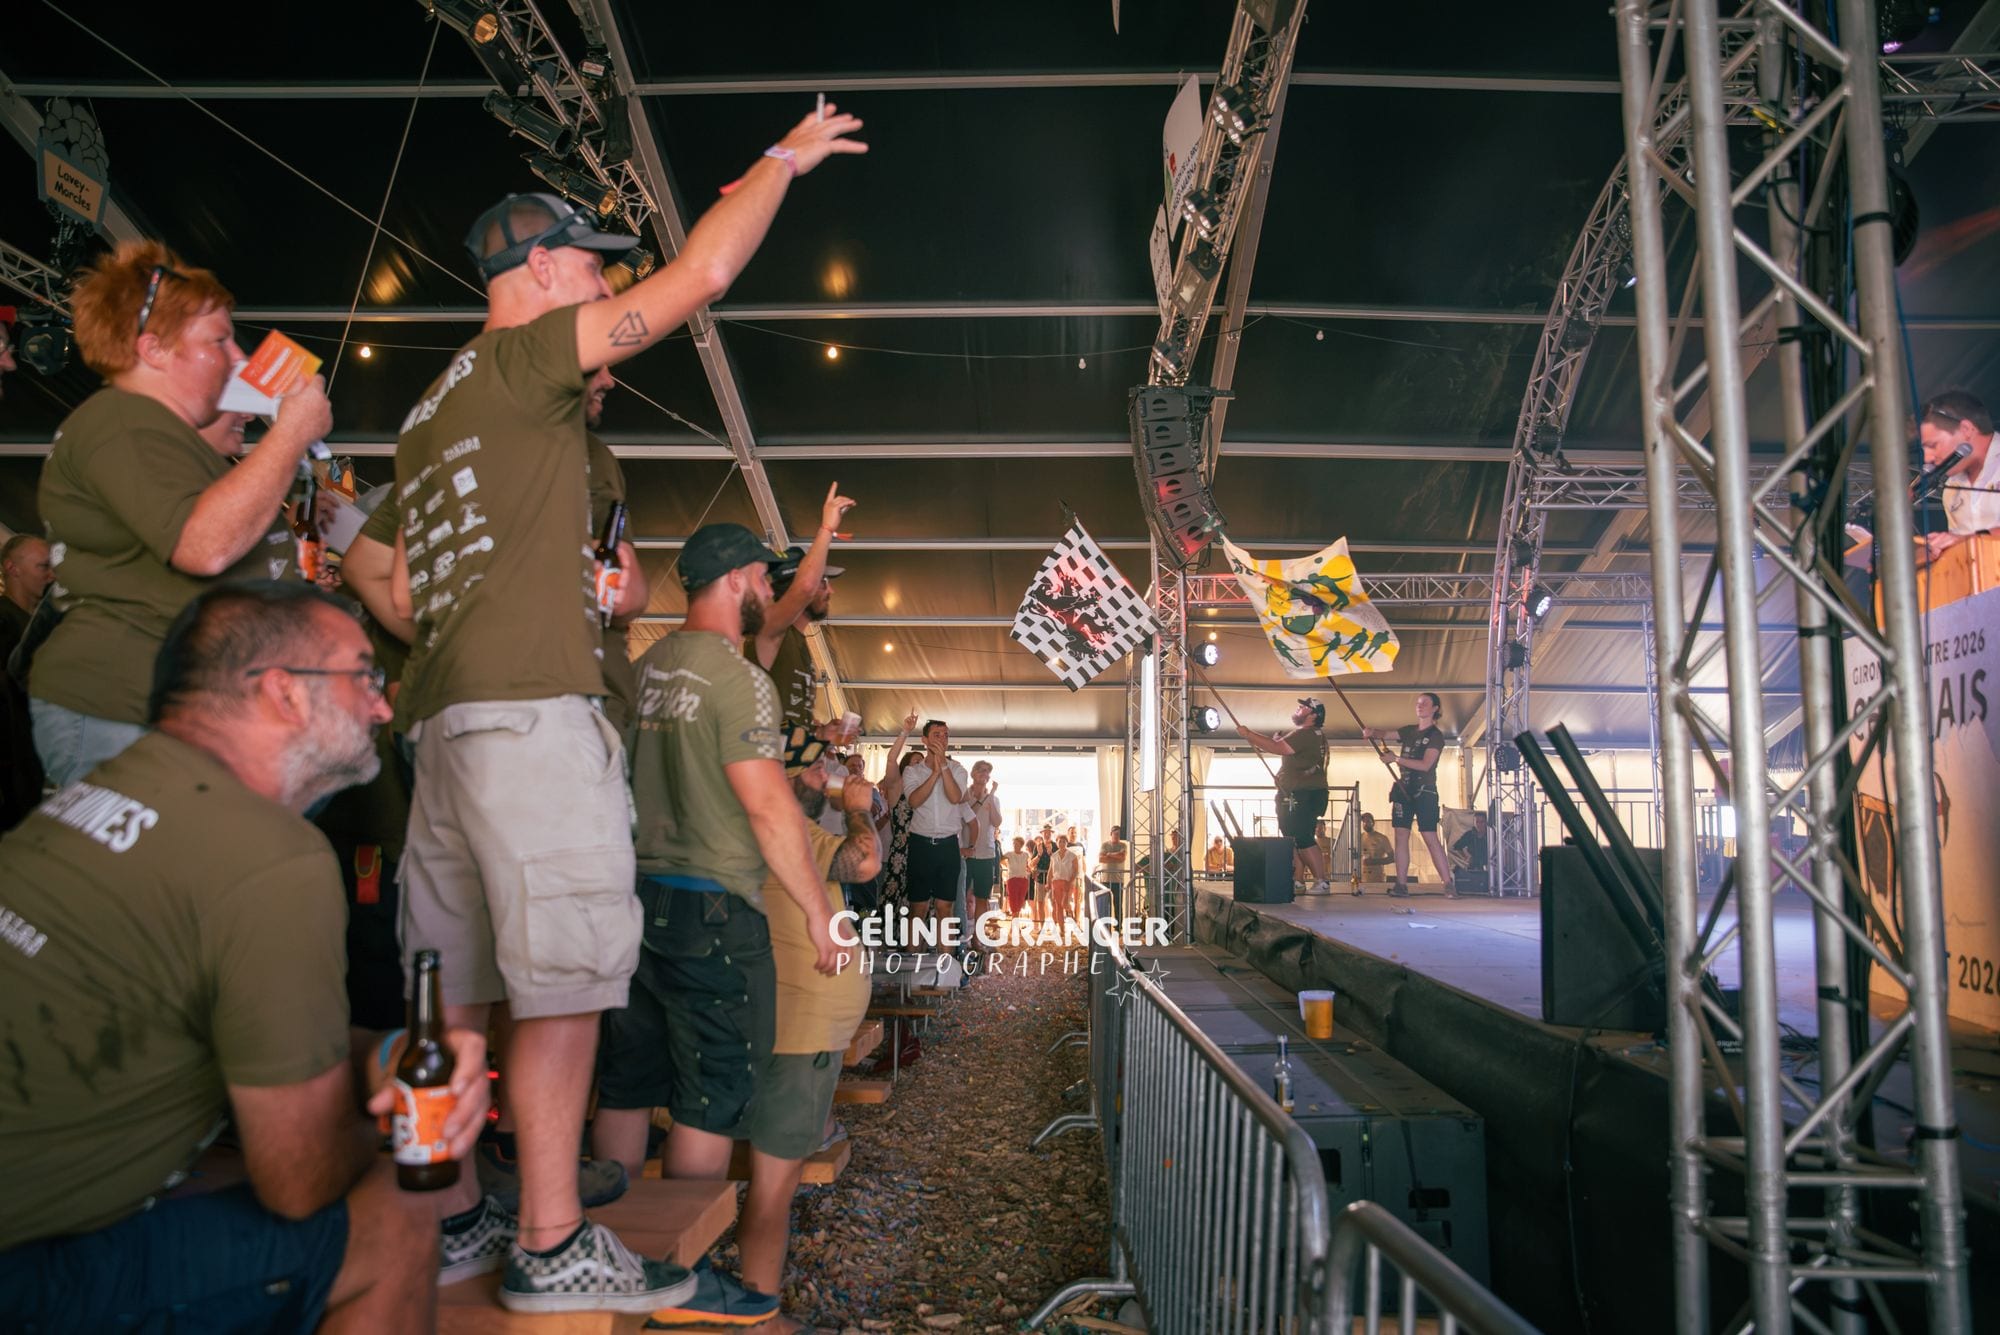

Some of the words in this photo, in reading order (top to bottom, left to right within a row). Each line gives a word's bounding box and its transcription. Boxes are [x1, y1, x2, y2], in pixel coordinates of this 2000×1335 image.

[54, 181, 91, 211] Morcles
[1924, 638, 1949, 666] TRE
[1953, 628, 1985, 659] 2026
